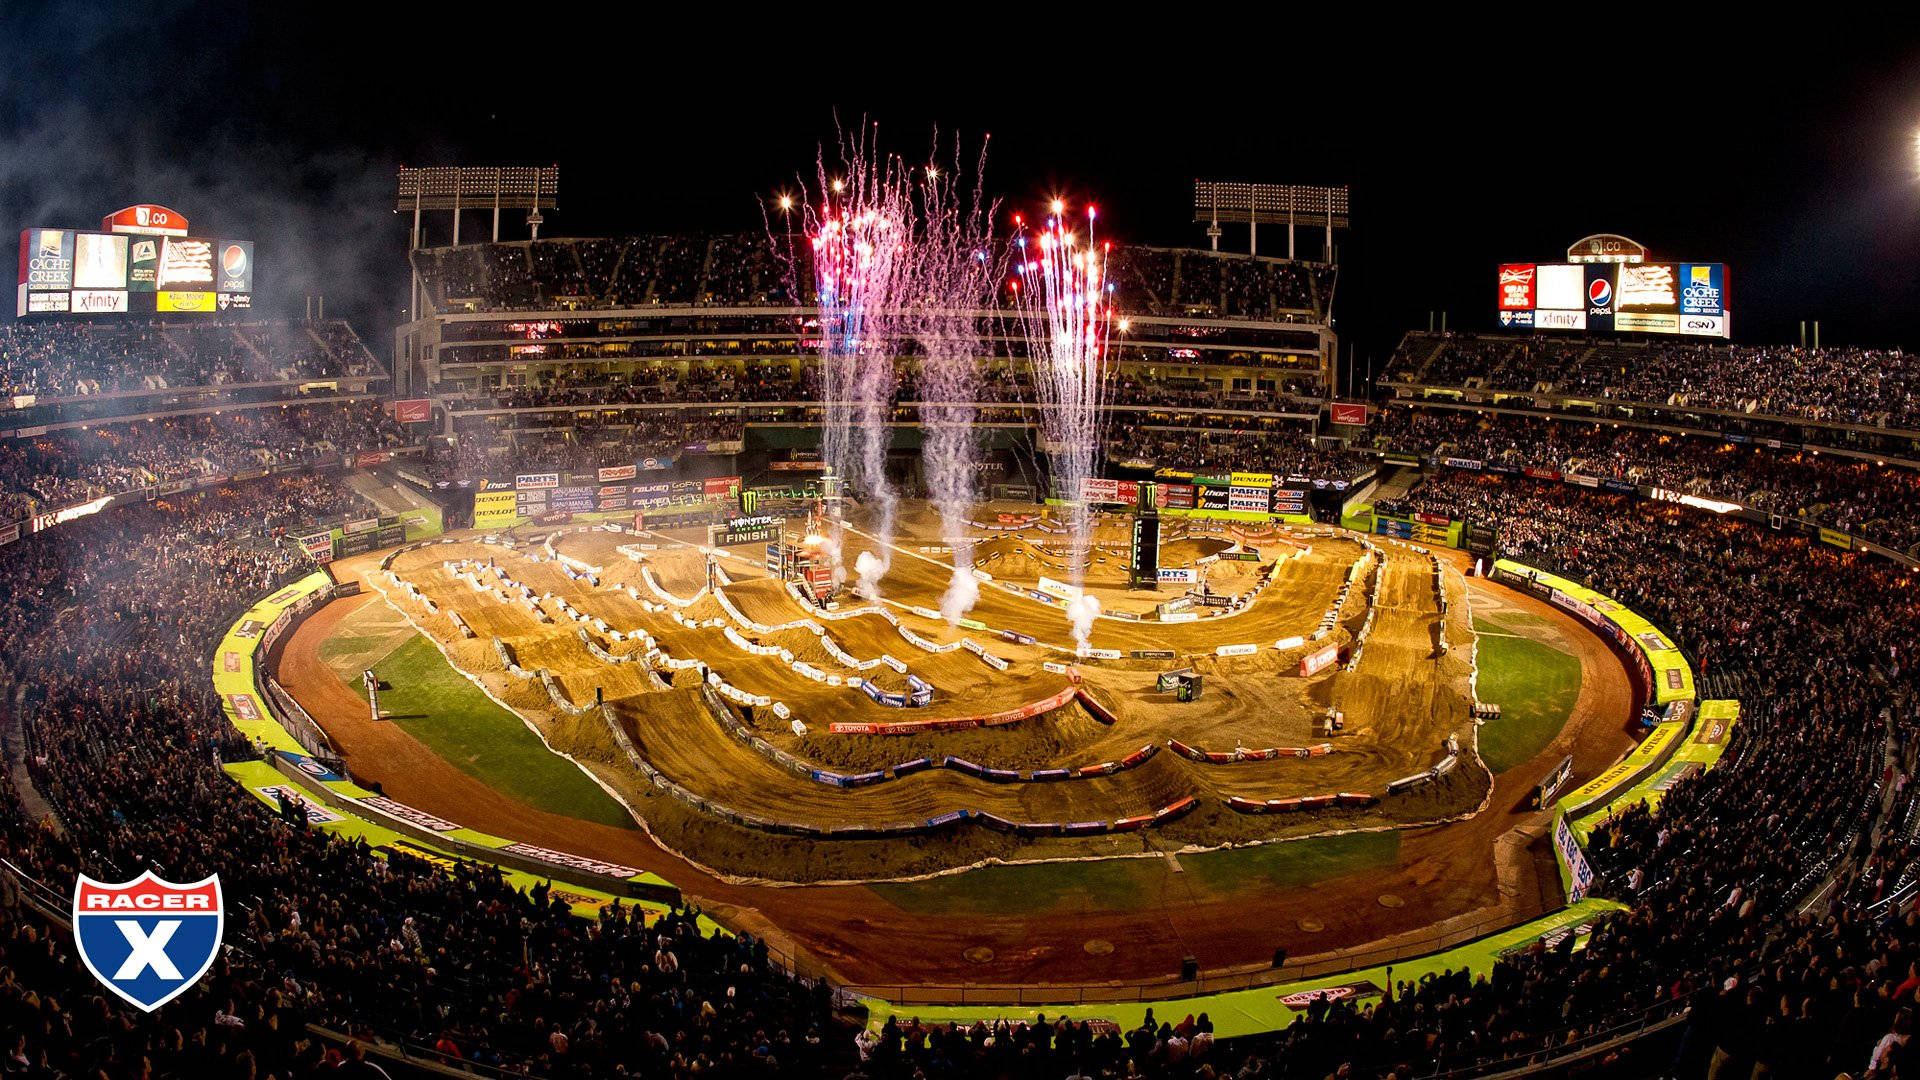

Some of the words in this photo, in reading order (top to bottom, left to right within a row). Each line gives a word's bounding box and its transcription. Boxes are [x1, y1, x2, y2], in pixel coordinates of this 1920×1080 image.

[29, 258, 70, 270] CACHE
[29, 271, 67, 282] CREEK
[1504, 285, 1529, 294] GRAB
[1683, 287, 1720, 298] CACHE
[80, 292, 119, 311] xfinity
[1683, 298, 1720, 308] CREEK
[1590, 307, 1612, 315] pepsi
[1543, 312, 1578, 327] xfinity
[1687, 320, 1710, 330] CSN
[1337, 415, 1360, 423] verizon
[517, 474, 557, 483] PARTS
[487, 482, 512, 490] thor
[633, 484, 669, 493] FALKEN
[672, 481, 702, 489] GoPro
[1204, 488, 1228, 497] thor
[1230, 487, 1268, 495] PARTS
[476, 495, 515, 503] DUNLOP
[1230, 499, 1268, 507] PARTS
[1204, 501, 1228, 510] thor
[476, 508, 516, 517] DUNLOP
[730, 516, 773, 527] MONSTER
[726, 531, 768, 543] FINISH
[897, 724, 926, 732] TOYOTA
[1641, 727, 1670, 755] DUNLOP
[1583, 765, 1630, 795] DUNLOP
